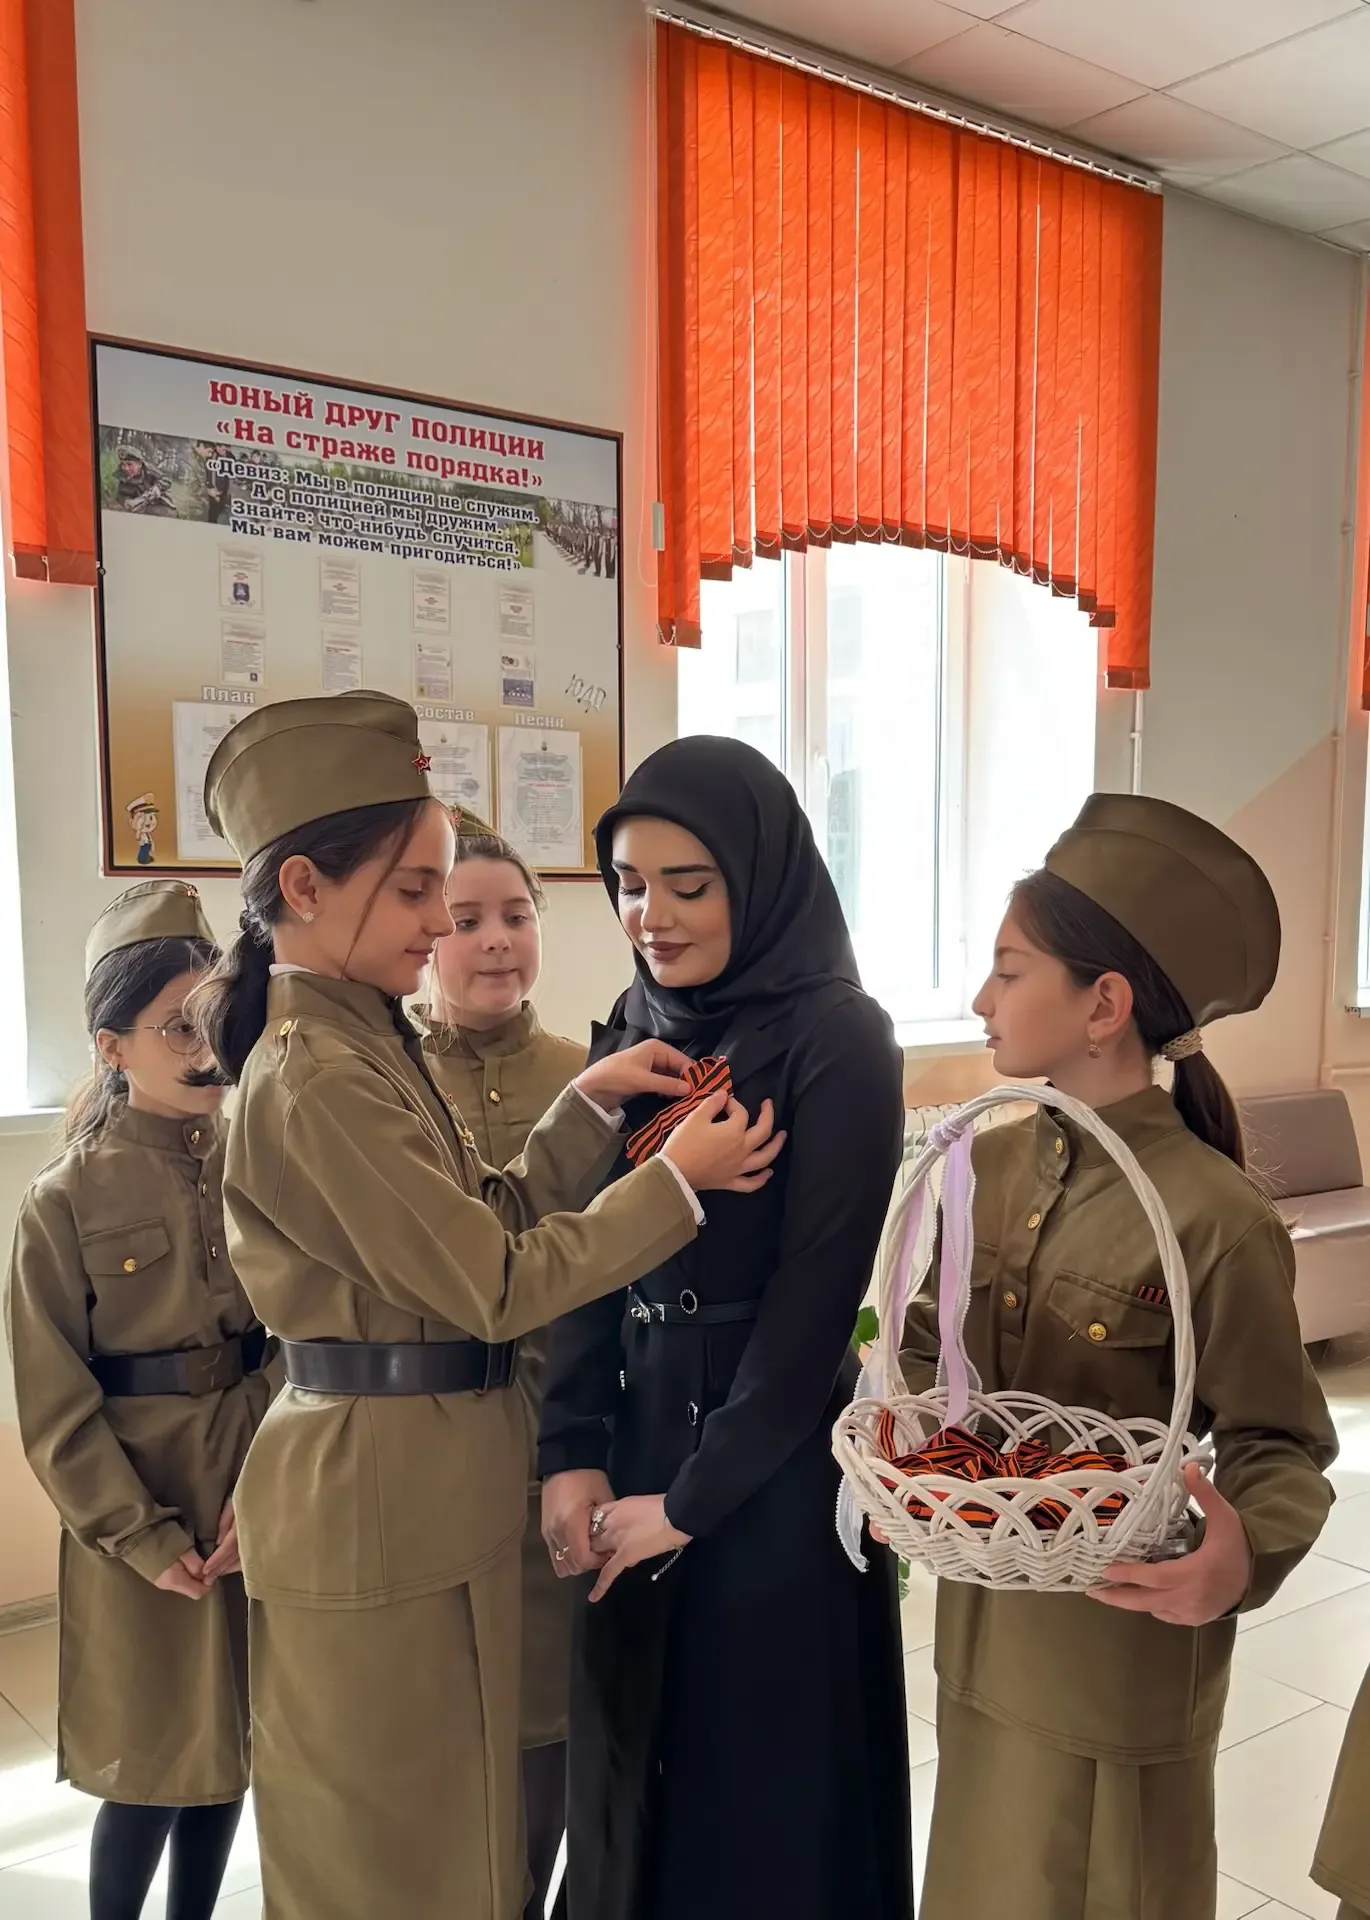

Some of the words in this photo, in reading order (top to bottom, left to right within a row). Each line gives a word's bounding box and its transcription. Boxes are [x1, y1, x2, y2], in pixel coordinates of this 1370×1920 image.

[209, 380, 314, 419] ЮНЫЙ
[325, 401, 400, 433] ДРУГ
[411, 416, 545, 461] ПОЛИЦИИ
[216, 418, 275, 445] «На
[286, 430, 396, 465] страже
[406, 451, 544, 488] порядка!»
[208, 459, 289, 482] «Девиз:
[296, 471, 329, 488] Мы
[336, 479, 347, 491] в
[354, 483, 433, 505] полиции
[440, 496, 460, 509] не
[466, 500, 540, 522] служим.
[252, 484, 267, 498] А
[273, 489, 285, 501] с
[291, 492, 385, 515] полицией
[392, 507, 421, 522] мы
[427, 512, 503, 534] дружим.
[231, 519, 265, 537] Мы
[273, 527, 311, 543] вам
[319, 534, 384, 553] можем
[390, 543, 521, 571] пригодиться!»
[232, 500, 314, 524] Знайте:
[319, 514, 426, 541] что-нибудь
[202, 685, 255, 704] План
[414, 703, 475, 722] Состав
[514, 712, 565, 728] Песня
